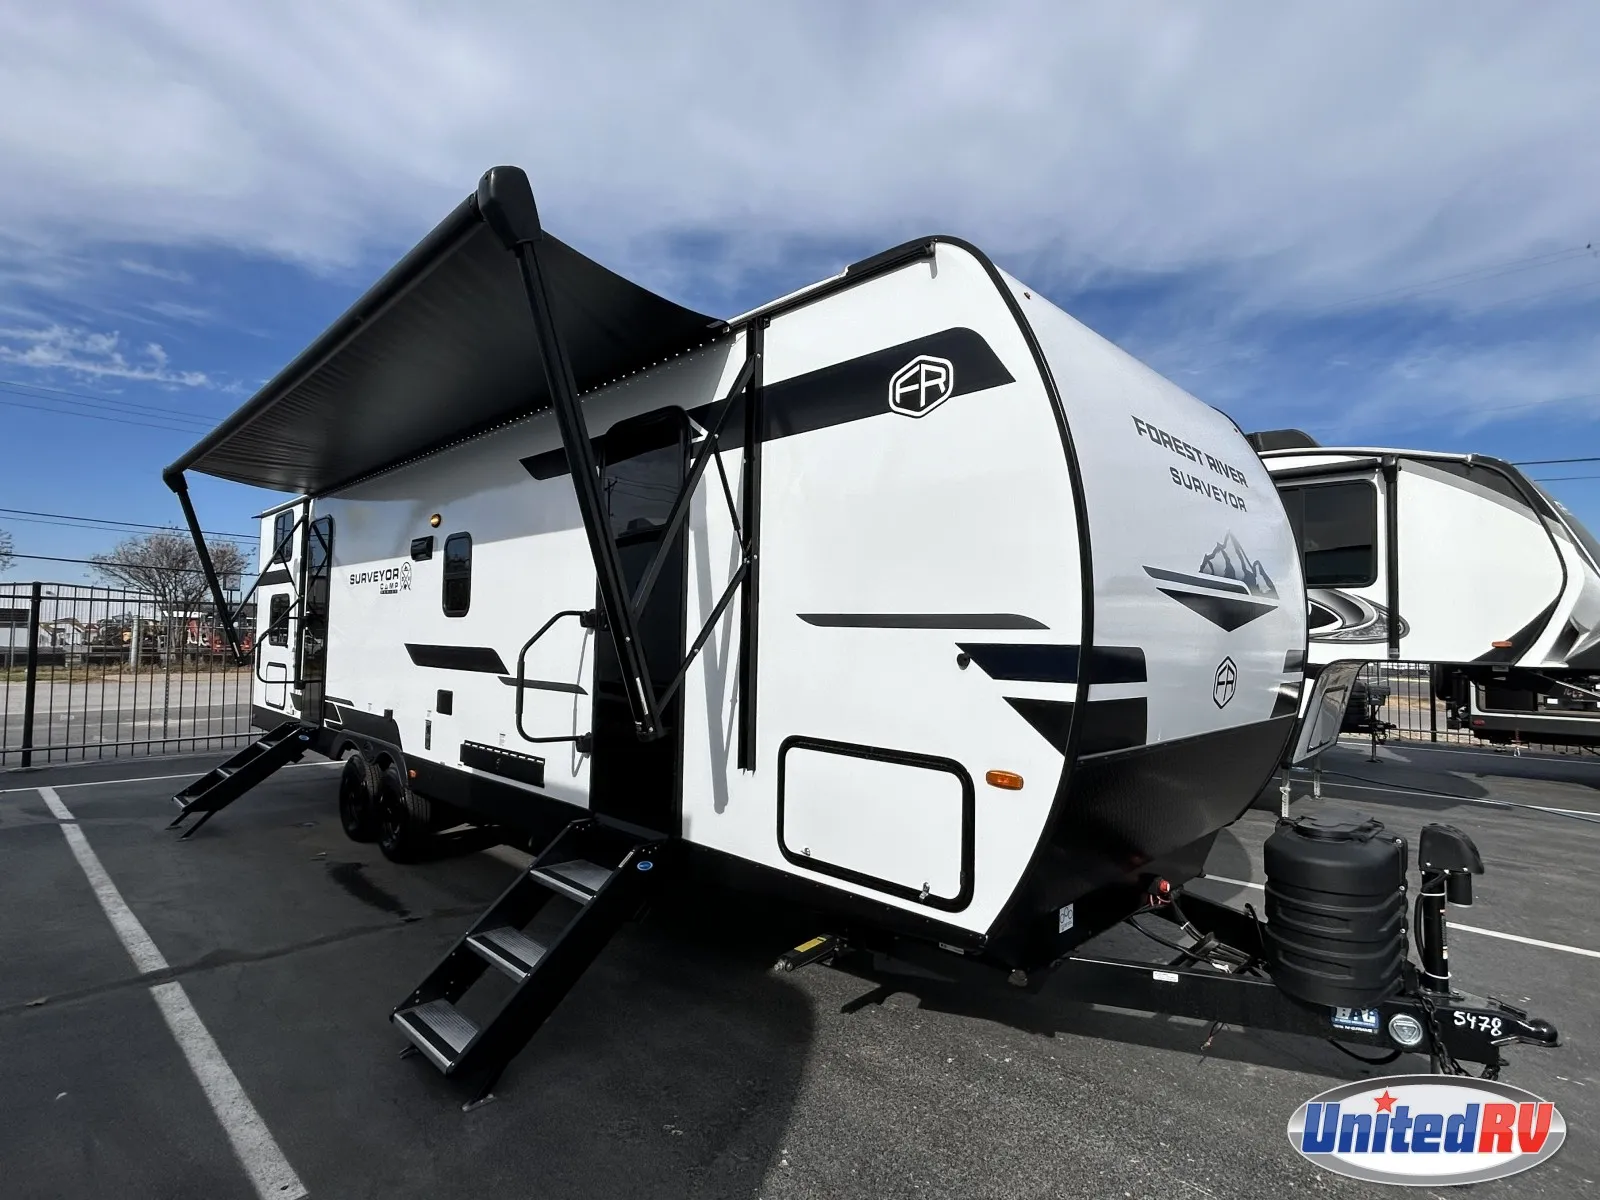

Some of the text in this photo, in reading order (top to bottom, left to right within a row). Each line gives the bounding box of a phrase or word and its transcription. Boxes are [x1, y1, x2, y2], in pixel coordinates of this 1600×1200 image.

[895, 363, 947, 408] FR
[1131, 415, 1249, 488] FOREST RIVER
[1169, 466, 1248, 512] SURVEYOR
[349, 567, 399, 585] SURVEYOR
[380, 582, 399, 590] CAMP
[1453, 1010, 1503, 1037] 5478
